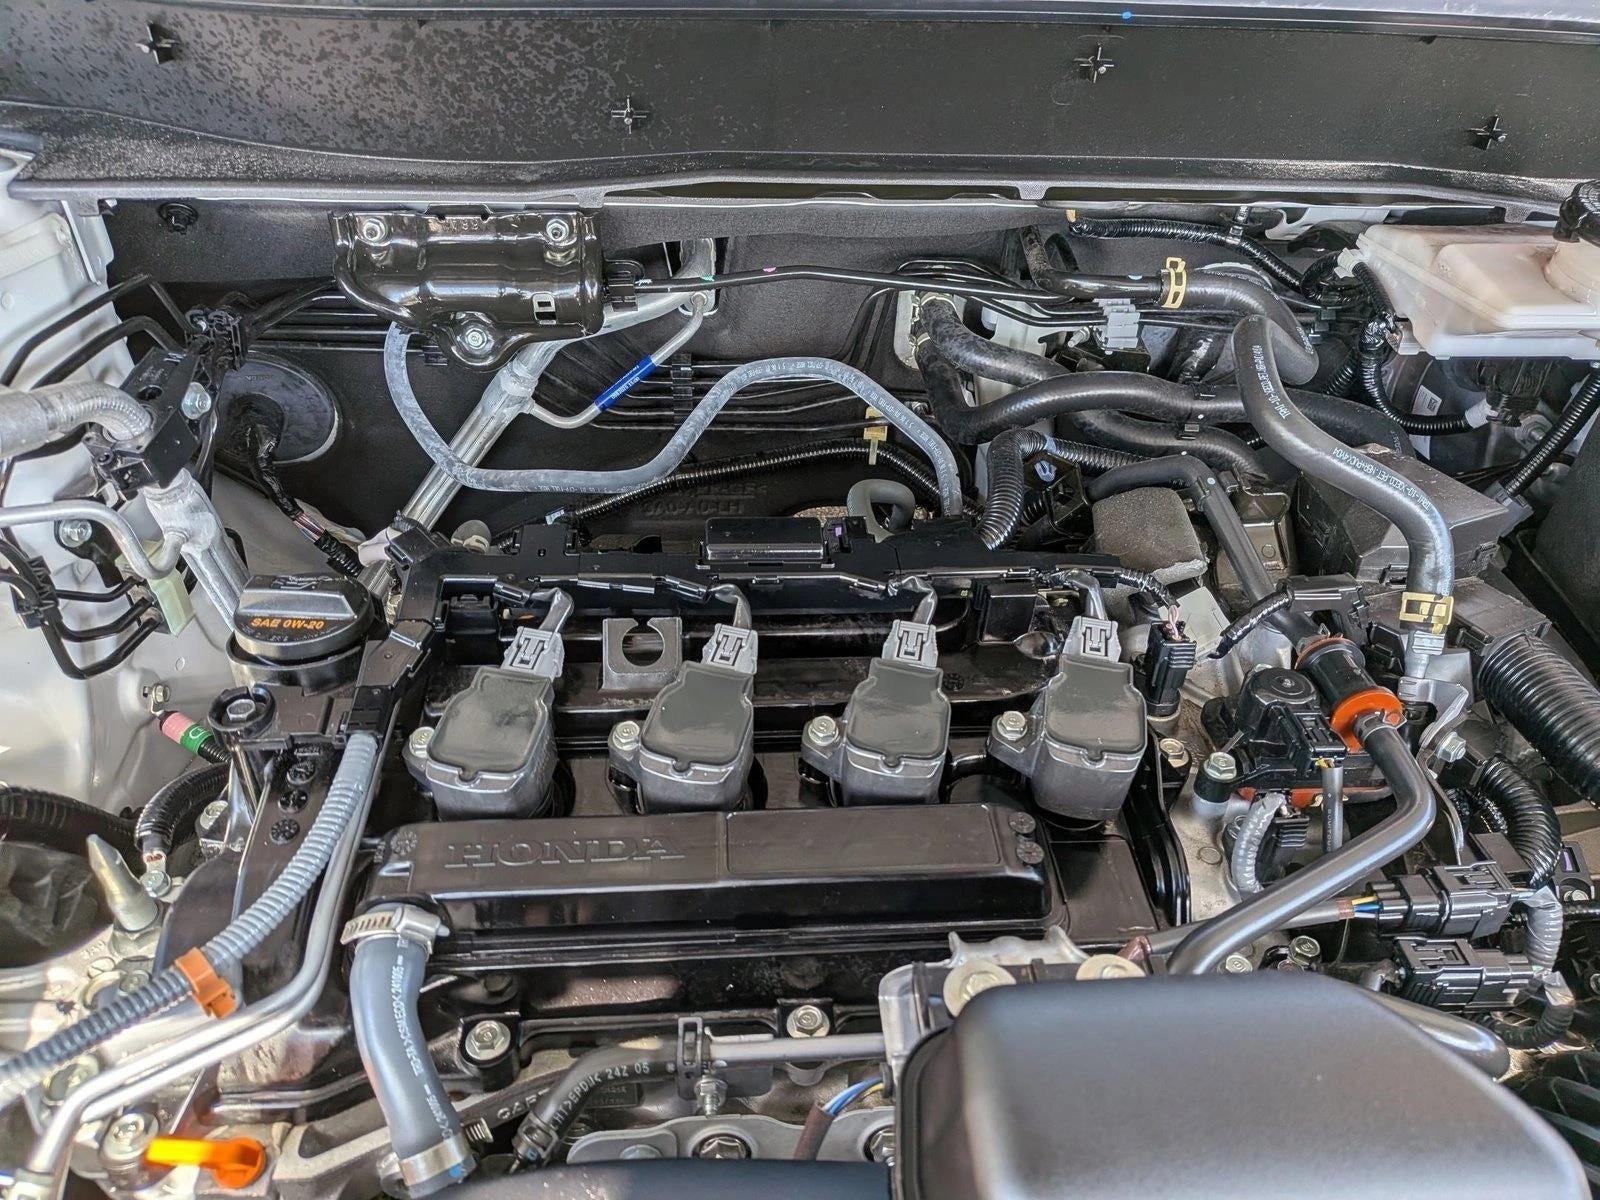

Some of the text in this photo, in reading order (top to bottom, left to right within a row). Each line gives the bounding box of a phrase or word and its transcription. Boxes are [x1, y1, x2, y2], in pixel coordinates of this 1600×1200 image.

[250, 616, 325, 629] SAE 0W-20
[444, 837, 685, 869] HONDA
